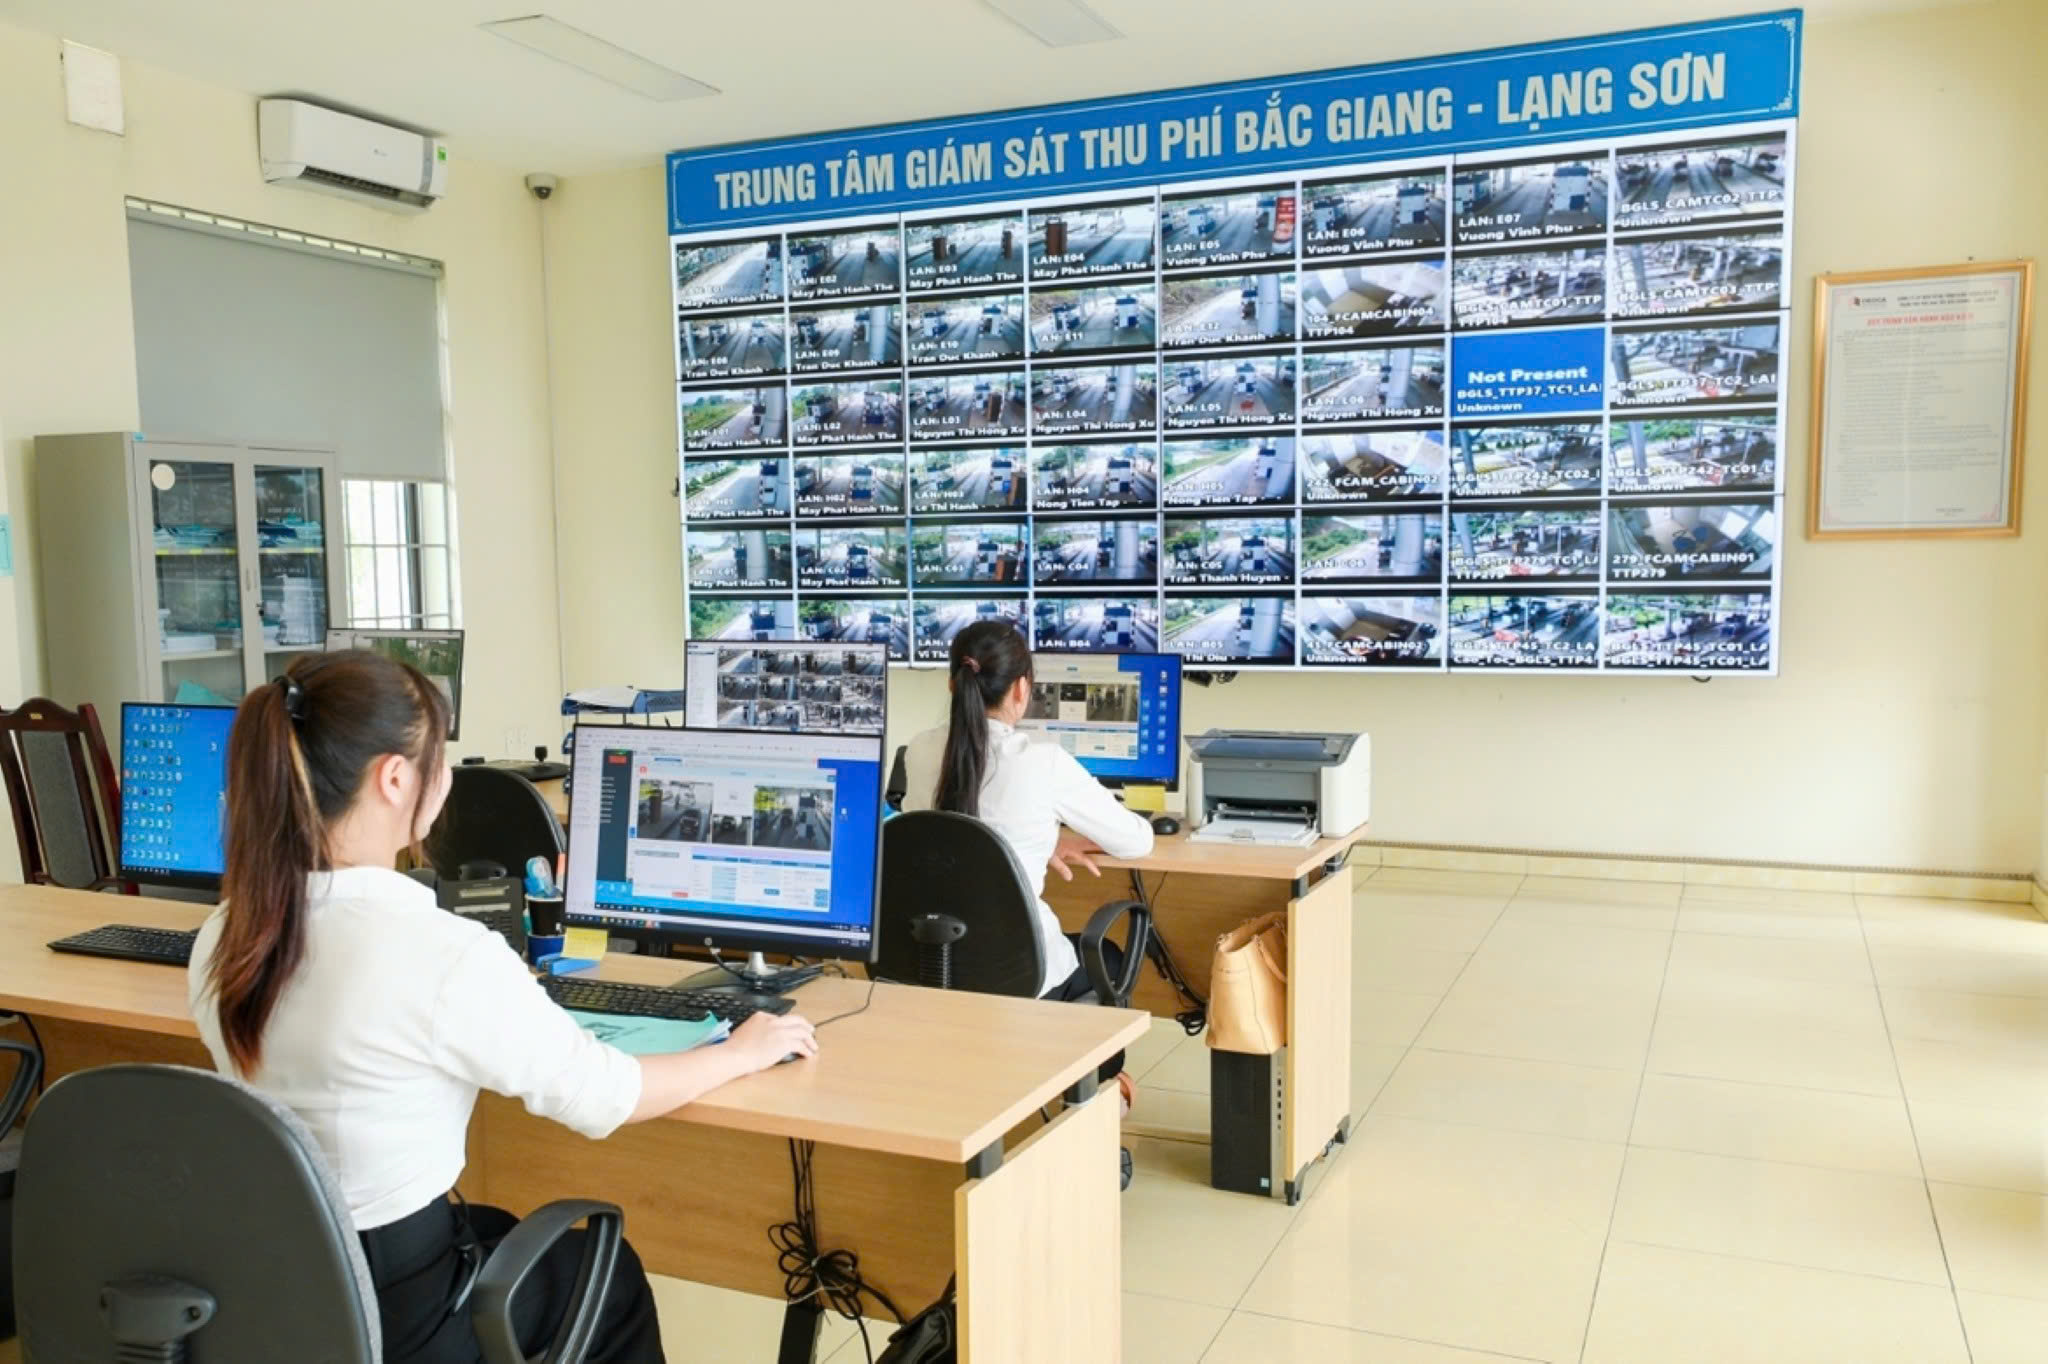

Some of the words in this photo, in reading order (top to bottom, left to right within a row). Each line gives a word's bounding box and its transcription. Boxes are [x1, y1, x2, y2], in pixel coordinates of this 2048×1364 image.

[715, 164, 815, 210] TRUNG
[826, 151, 895, 197] TÂM
[906, 138, 992, 187] GIÁM
[1004, 127, 1070, 178] SÁT
[1080, 123, 1148, 170] THU
[1161, 105, 1222, 161] PHÍ
[1236, 86, 1314, 153] BẮC
[1327, 87, 1454, 144] GIANG
[1498, 68, 1612, 131] LẠNG
[1630, 52, 1726, 109] SƠN
[1459, 217, 1494, 228] LAN:
[1497, 214, 1521, 224] E07
[1458, 231, 1504, 242] Vuong
[1545, 224, 1574, 234] Phu
[1307, 244, 1349, 255] Vuong
[1388, 238, 1414, 247] Phu
[1064, 254, 1085, 262] E04
[1167, 256, 1206, 267] Vuong
[1241, 251, 1266, 260] Phu
[1034, 268, 1058, 279] May
[1061, 266, 1087, 276] Phat
[1090, 264, 1122, 273] Hanh
[1125, 262, 1147, 270] The
[910, 280, 933, 289] May
[936, 276, 961, 286] Phat
[963, 274, 993, 284] Hanh
[997, 272, 1017, 280] The
[817, 286, 841, 296] Phat
[875, 283, 894, 291] The
[1468, 371, 1505, 384] Not
[1511, 366, 1588, 382] Present
[1457, 383, 1601, 400] BGLS_TTP37_TC1_LA
[1457, 402, 1523, 413] Unknown
[821, 434, 845, 443] Phat
[878, 431, 897, 440] The
[767, 507, 784, 516] The
[823, 506, 847, 515] Phat
[880, 504, 899, 512] The
[768, 578, 786, 586] The
[881, 577, 900, 586] The
[1169, 575, 1195, 583] Tran
[1200, 574, 1237, 583] Thanh
[1241, 574, 1281, 584] Huyen
